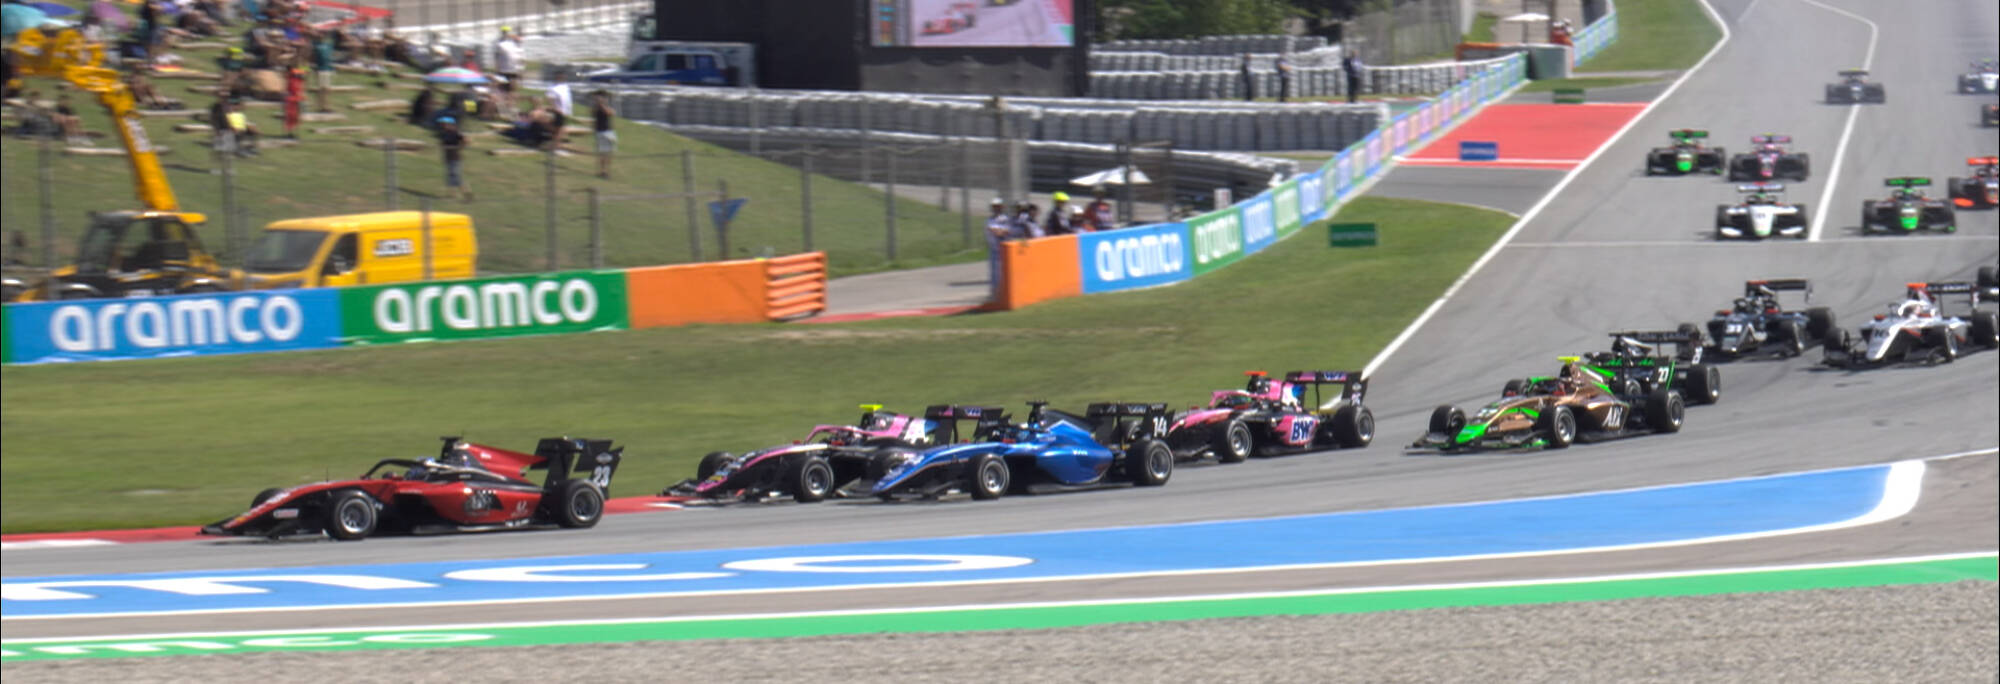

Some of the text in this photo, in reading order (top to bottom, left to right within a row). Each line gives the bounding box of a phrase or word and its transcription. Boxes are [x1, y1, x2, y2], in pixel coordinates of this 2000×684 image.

[1095, 232, 1183, 280] aramco
[51, 296, 302, 351] aramco
[375, 279, 598, 332] aramco
[1153, 416, 1167, 437] 14
[593, 466, 610, 487] 23
